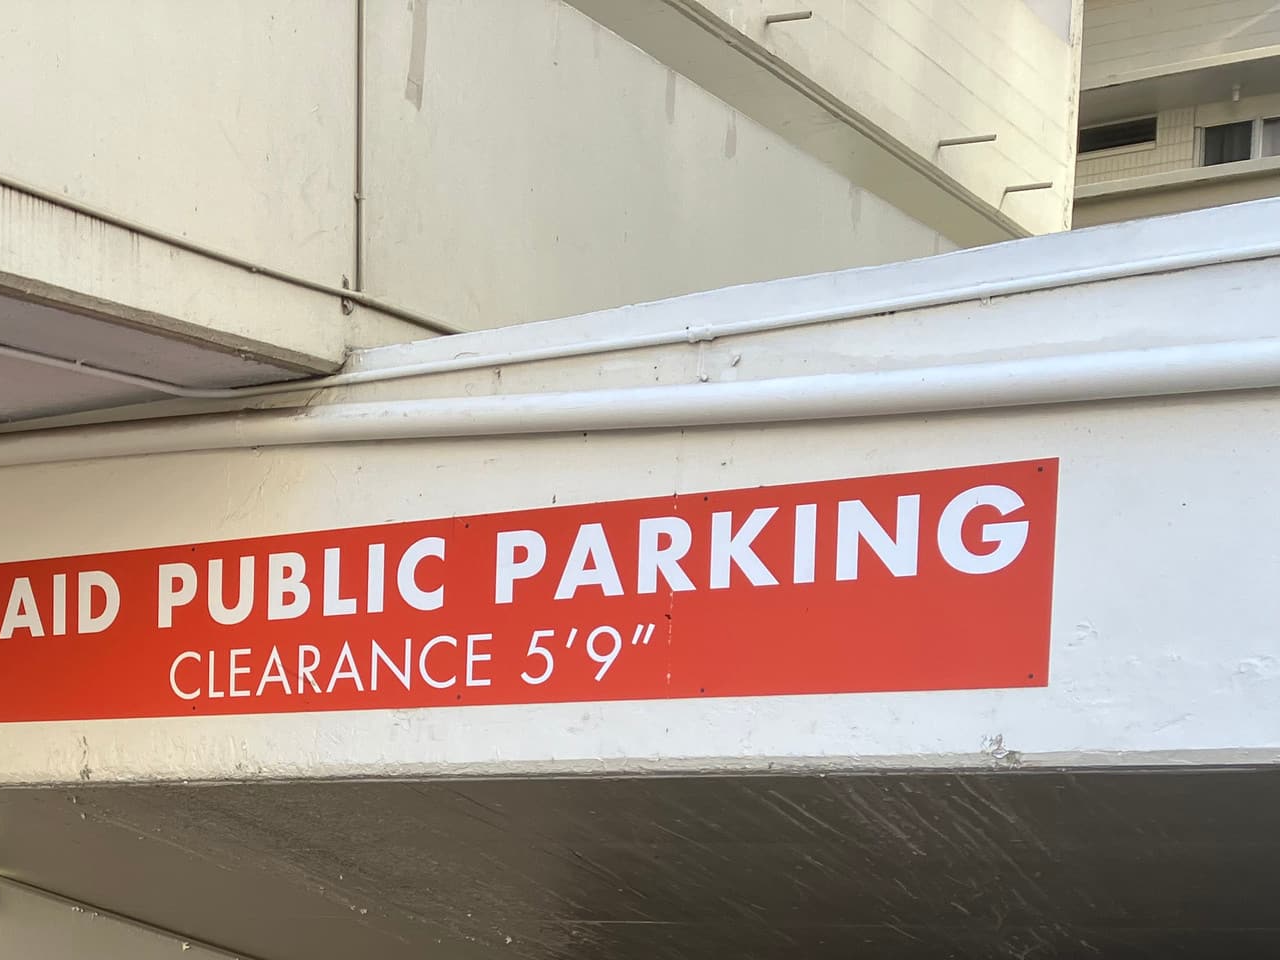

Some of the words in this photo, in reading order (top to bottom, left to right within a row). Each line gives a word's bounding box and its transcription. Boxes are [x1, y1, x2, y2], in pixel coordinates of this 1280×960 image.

[157, 536, 446, 629] PUBLIC
[495, 484, 1030, 604] PARKING
[169, 633, 493, 700] CLEARANCE
[520, 623, 656, 685] 5'9"
